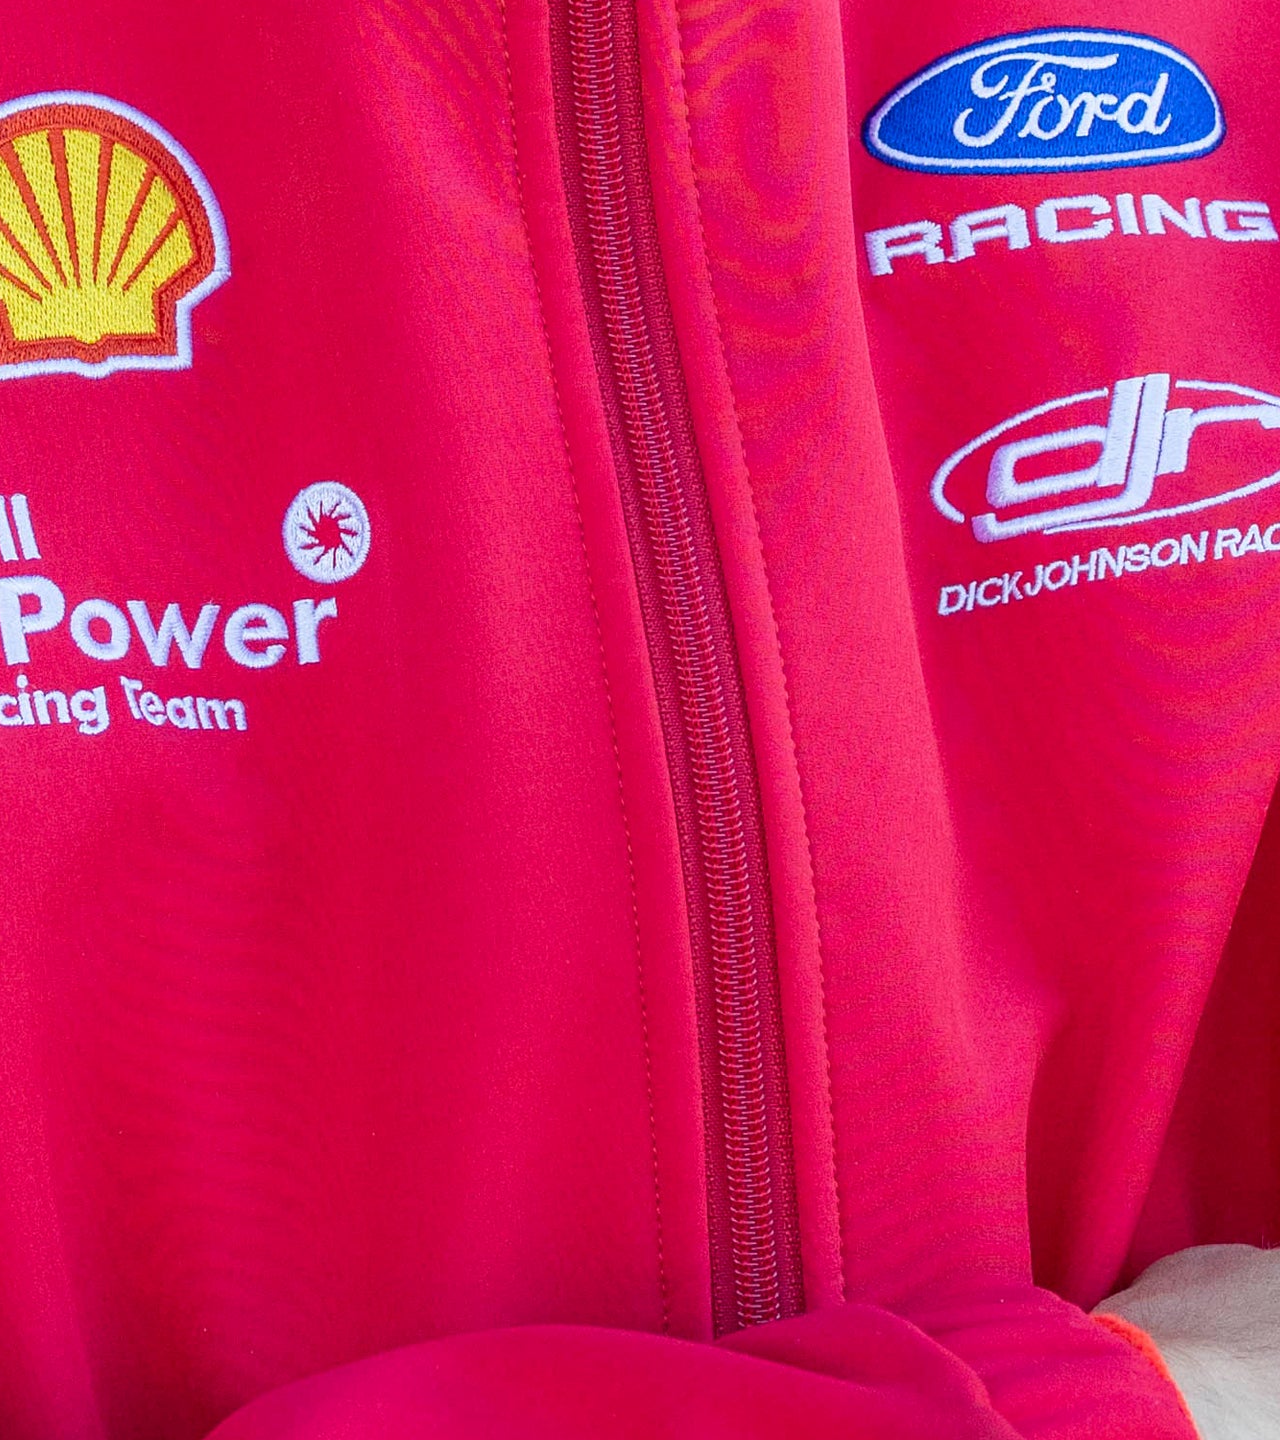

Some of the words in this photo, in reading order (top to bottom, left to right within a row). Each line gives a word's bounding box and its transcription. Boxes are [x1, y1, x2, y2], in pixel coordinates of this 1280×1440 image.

[952, 52, 1172, 148] Ford
[864, 193, 1280, 276] RACING
[937, 571, 1025, 616] DICK
[1021, 531, 1207, 598] JOHNSON
[120, 676, 248, 731] Team
